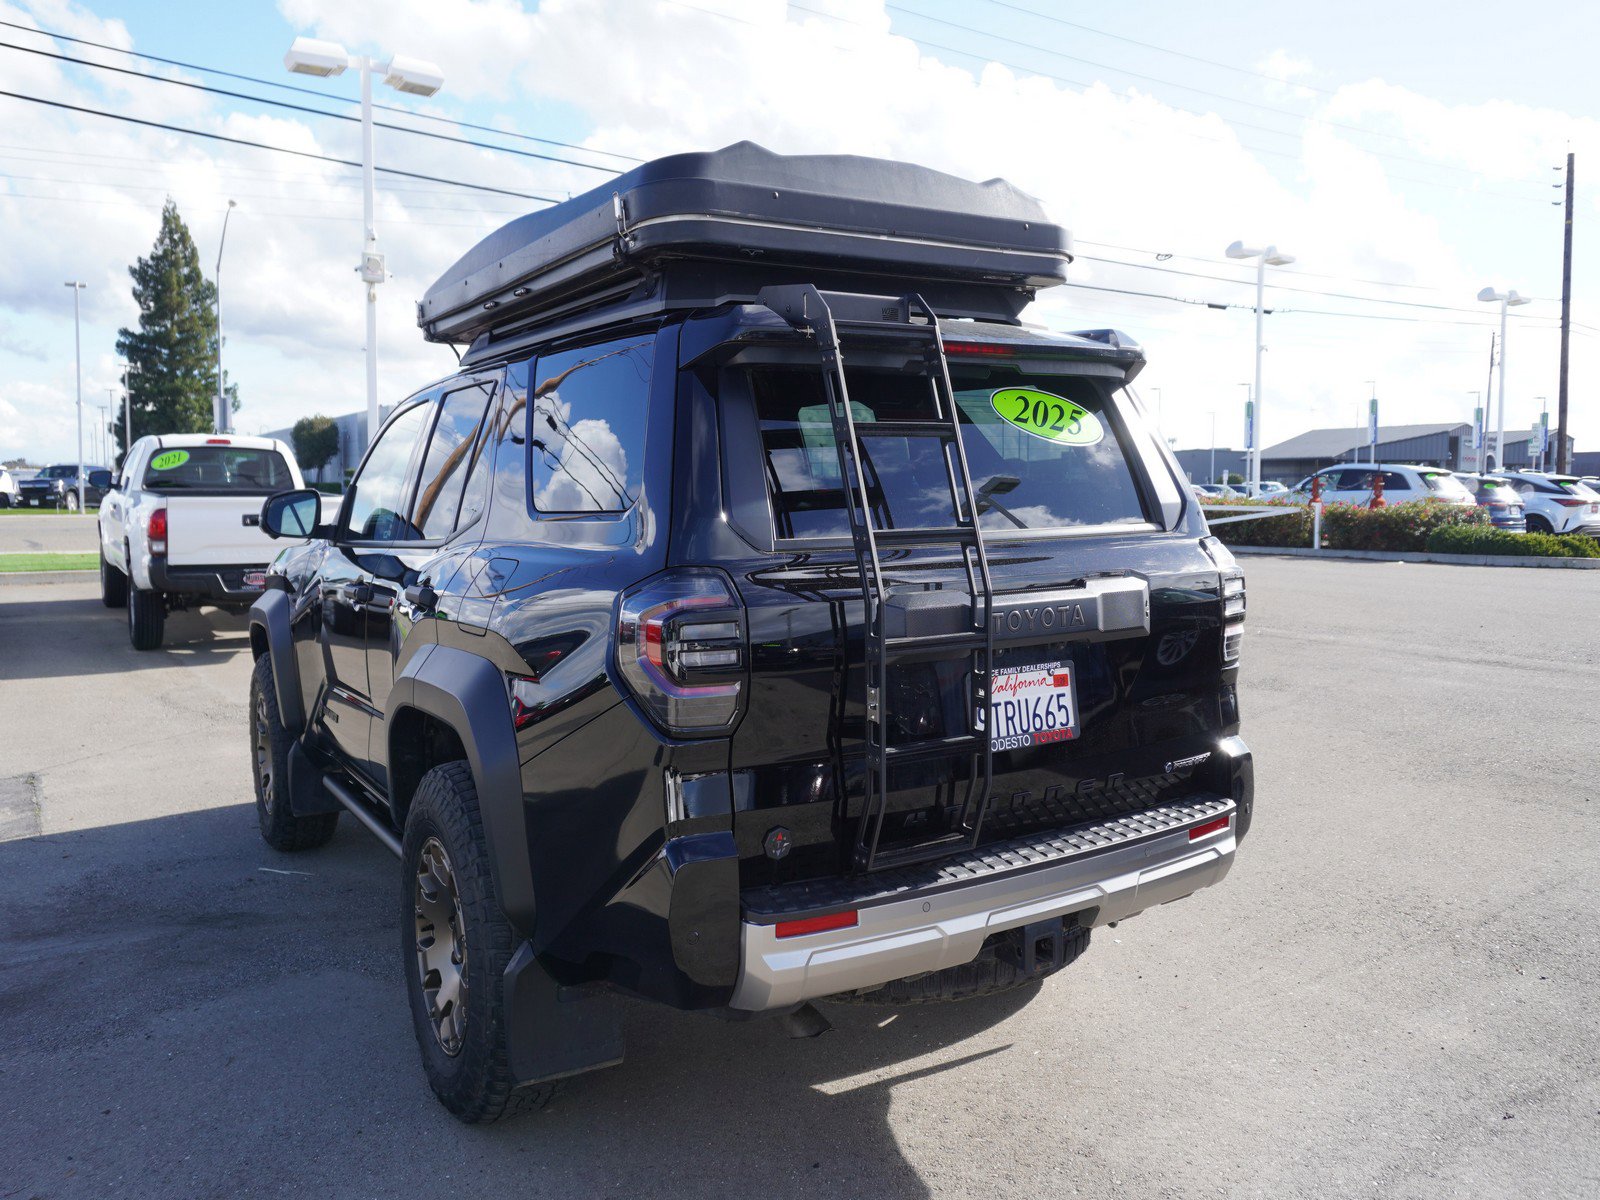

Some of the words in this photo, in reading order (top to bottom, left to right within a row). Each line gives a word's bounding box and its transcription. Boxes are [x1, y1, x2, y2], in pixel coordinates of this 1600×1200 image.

[1013, 395, 1083, 435] 2025
[158, 452, 181, 468] 2021
[991, 603, 1085, 634] TOYOTA
[1000, 666, 1021, 675] FAMILY
[1021, 661, 1061, 673] DEALERSHIPS
[991, 673, 1054, 697] California
[990, 734, 1031, 752] ODESTO
[1033, 727, 1073, 745] TOYOTA
